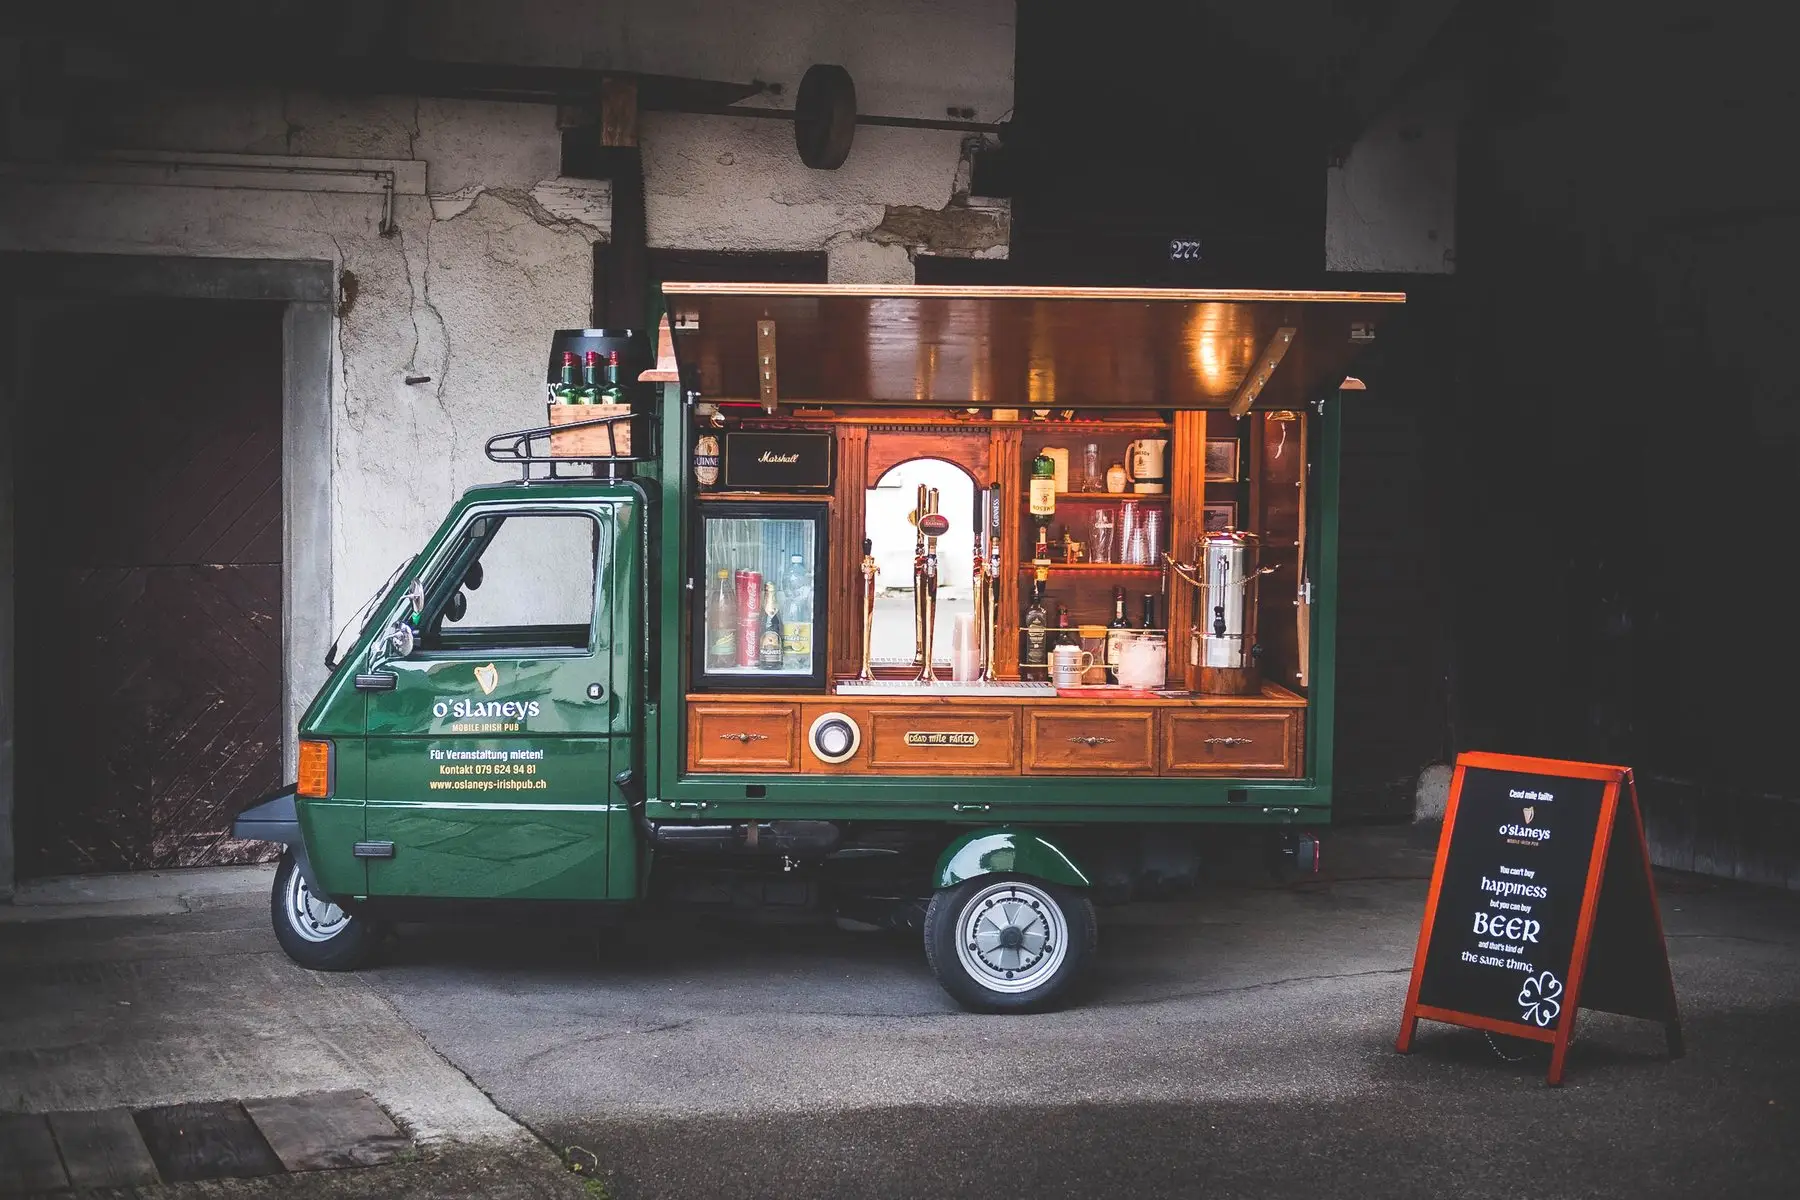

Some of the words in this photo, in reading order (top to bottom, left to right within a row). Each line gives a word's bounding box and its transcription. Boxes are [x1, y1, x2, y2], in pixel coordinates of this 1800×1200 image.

[1172, 240, 1200, 259] 277
[757, 450, 799, 463] Marshall
[992, 498, 1000, 527] GUINNESS
[452, 723, 480, 732] MOBILE
[481, 723, 502, 732] IRISH
[504, 723, 520, 731] PUB
[430, 749, 445, 760] Für
[446, 749, 508, 762] Veranstaltung
[510, 749, 544, 760] mieten!
[440, 765, 474, 775] Kontakt
[475, 765, 492, 775] 079
[494, 765, 511, 775] 624
[512, 765, 524, 775] 94
[526, 765, 536, 775] 81
[430, 780, 547, 791] www.oslaneys-irishpub.ch
[1500, 865, 1510, 875] You
[1510, 868, 1523, 876] can't
[1524, 869, 1535, 879] buy
[1481, 876, 1547, 899] happiness
[1489, 899, 1500, 908] but
[1499, 901, 1510, 910] you
[1510, 903, 1521, 911] can
[1520, 904, 1531, 914] buy
[1473, 911, 1541, 943] BEER
[1478, 941, 1489, 949] and
[1489, 941, 1505, 952] that's
[1505, 944, 1517, 953] kind
[1516, 946, 1524, 954] of
[1461, 951, 1479, 963] the
[1479, 955, 1505, 967] same
[1506, 959, 1534, 973] thing.
